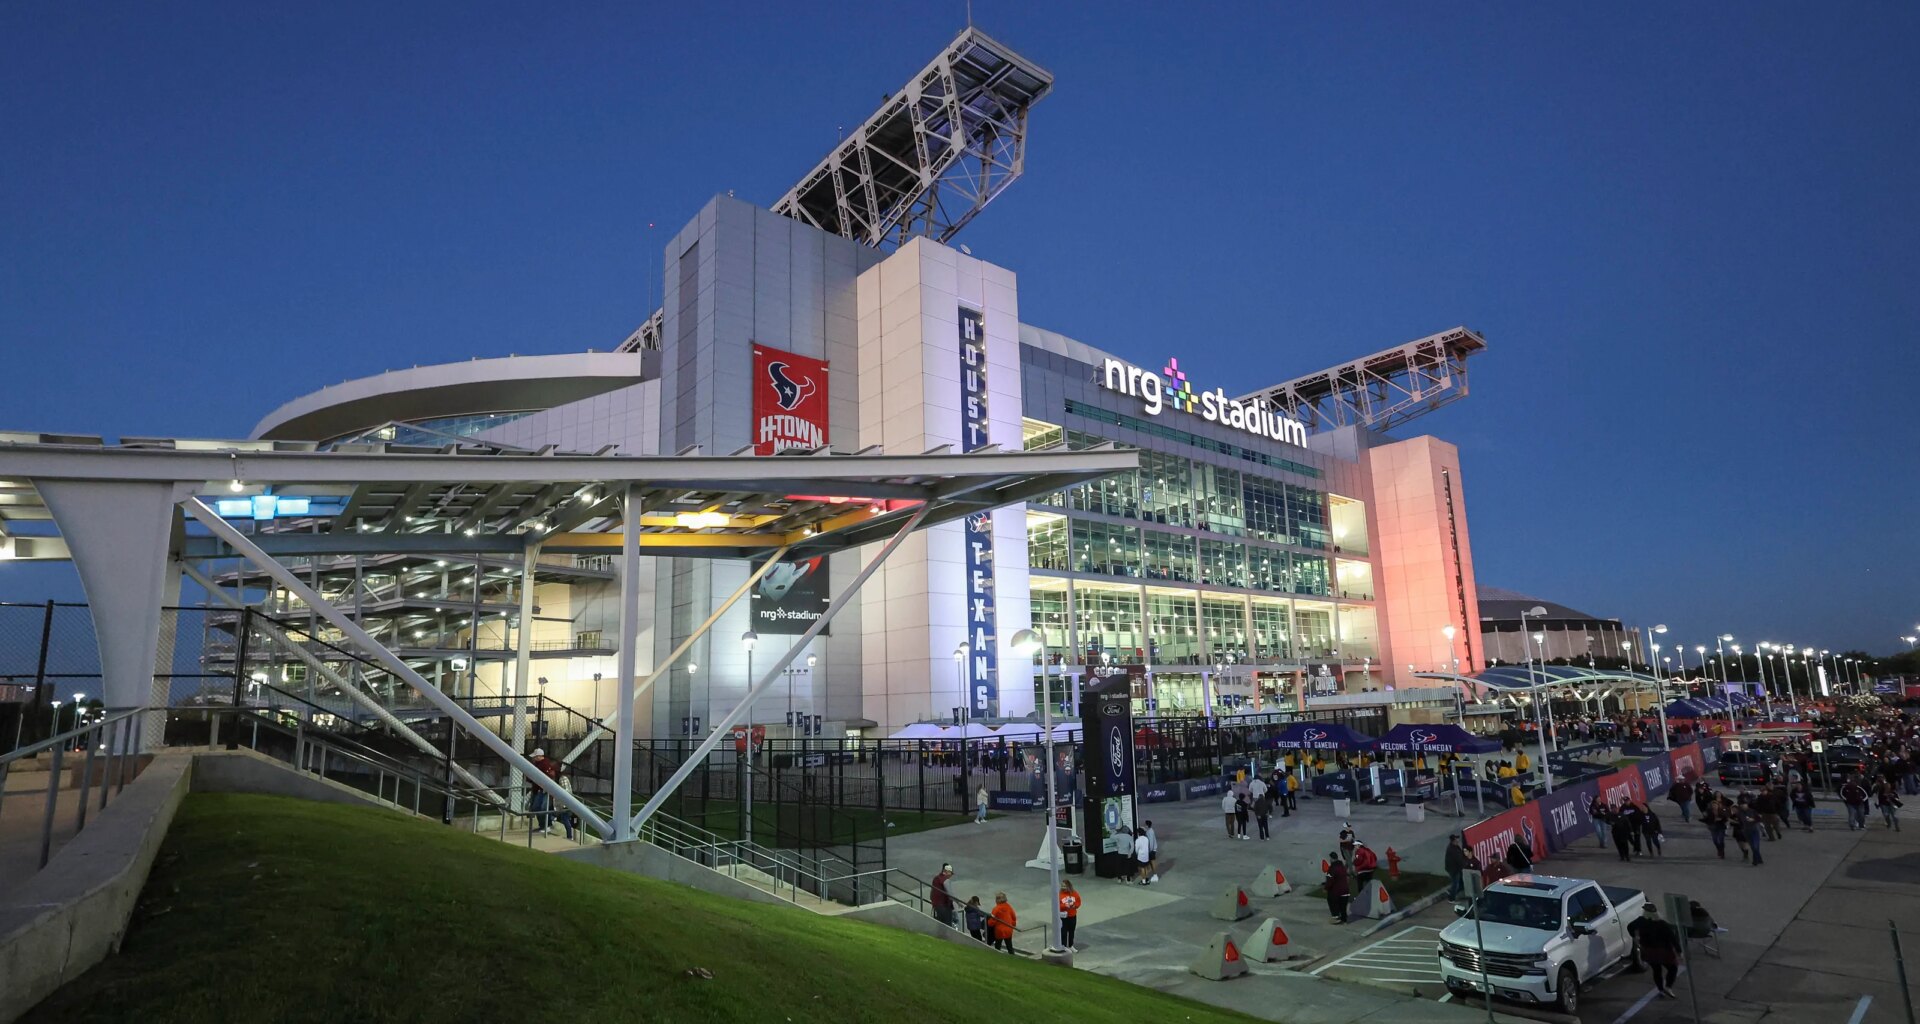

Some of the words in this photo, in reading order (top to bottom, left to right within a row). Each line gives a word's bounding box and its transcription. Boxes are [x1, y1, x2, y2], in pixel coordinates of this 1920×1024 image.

[964, 317, 980, 453] HOUST
[1104, 357, 1163, 416] nrg
[1201, 387, 1307, 448] stadium
[760, 610, 777, 620] nrg
[787, 610, 822, 620] stadium
[971, 541, 988, 710] TEXANS
[1112, 736, 1122, 767] Ford
[1314, 741, 1338, 749] GAMEDAY
[1380, 742, 1407, 751] WELCOME
[1424, 744, 1452, 752] GAMEDAY
[1551, 802, 1577, 835] TEXANS
